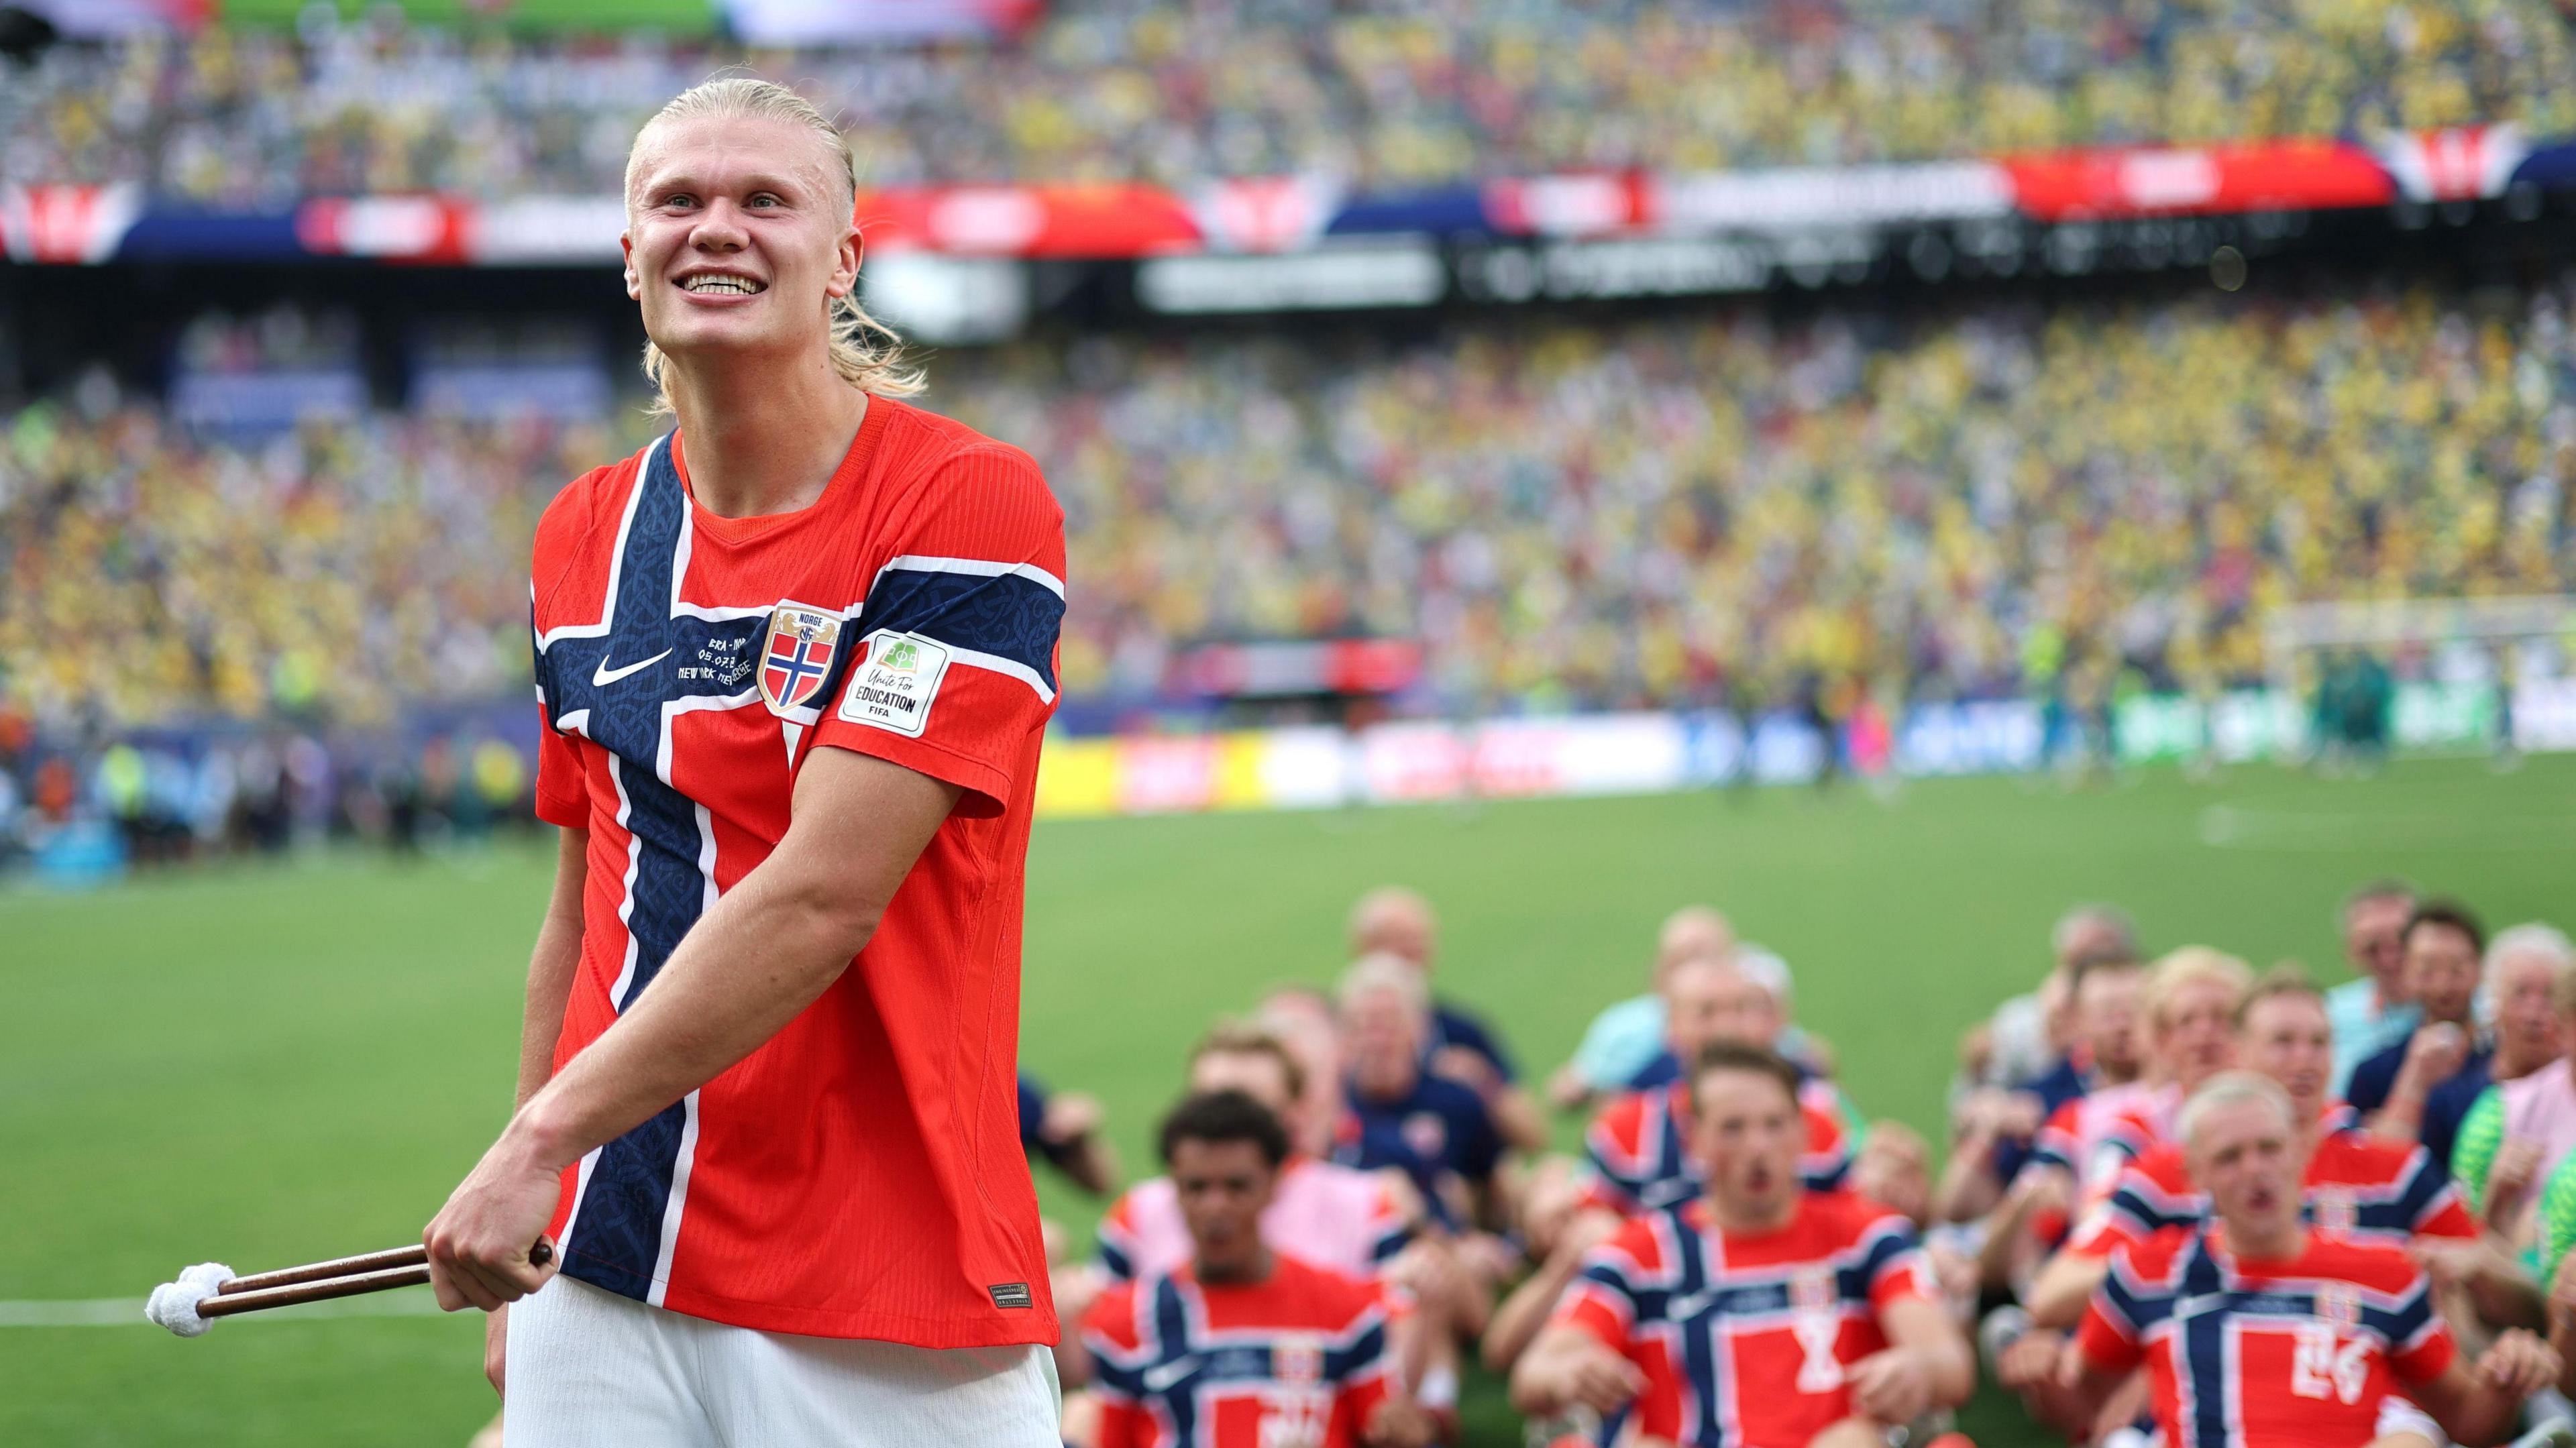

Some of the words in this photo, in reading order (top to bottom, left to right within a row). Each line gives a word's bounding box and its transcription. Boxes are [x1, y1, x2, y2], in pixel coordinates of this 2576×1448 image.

[799, 613, 823, 626] NORGE
[708, 638, 727, 651] BRA
[698, 649, 735, 668] 05.07.2
[678, 667, 698, 679] NEW
[867, 669, 896, 686] Unite
[896, 676, 914, 691] For
[855, 685, 916, 714] EDUCATION
[869, 706, 890, 717] FIFA
